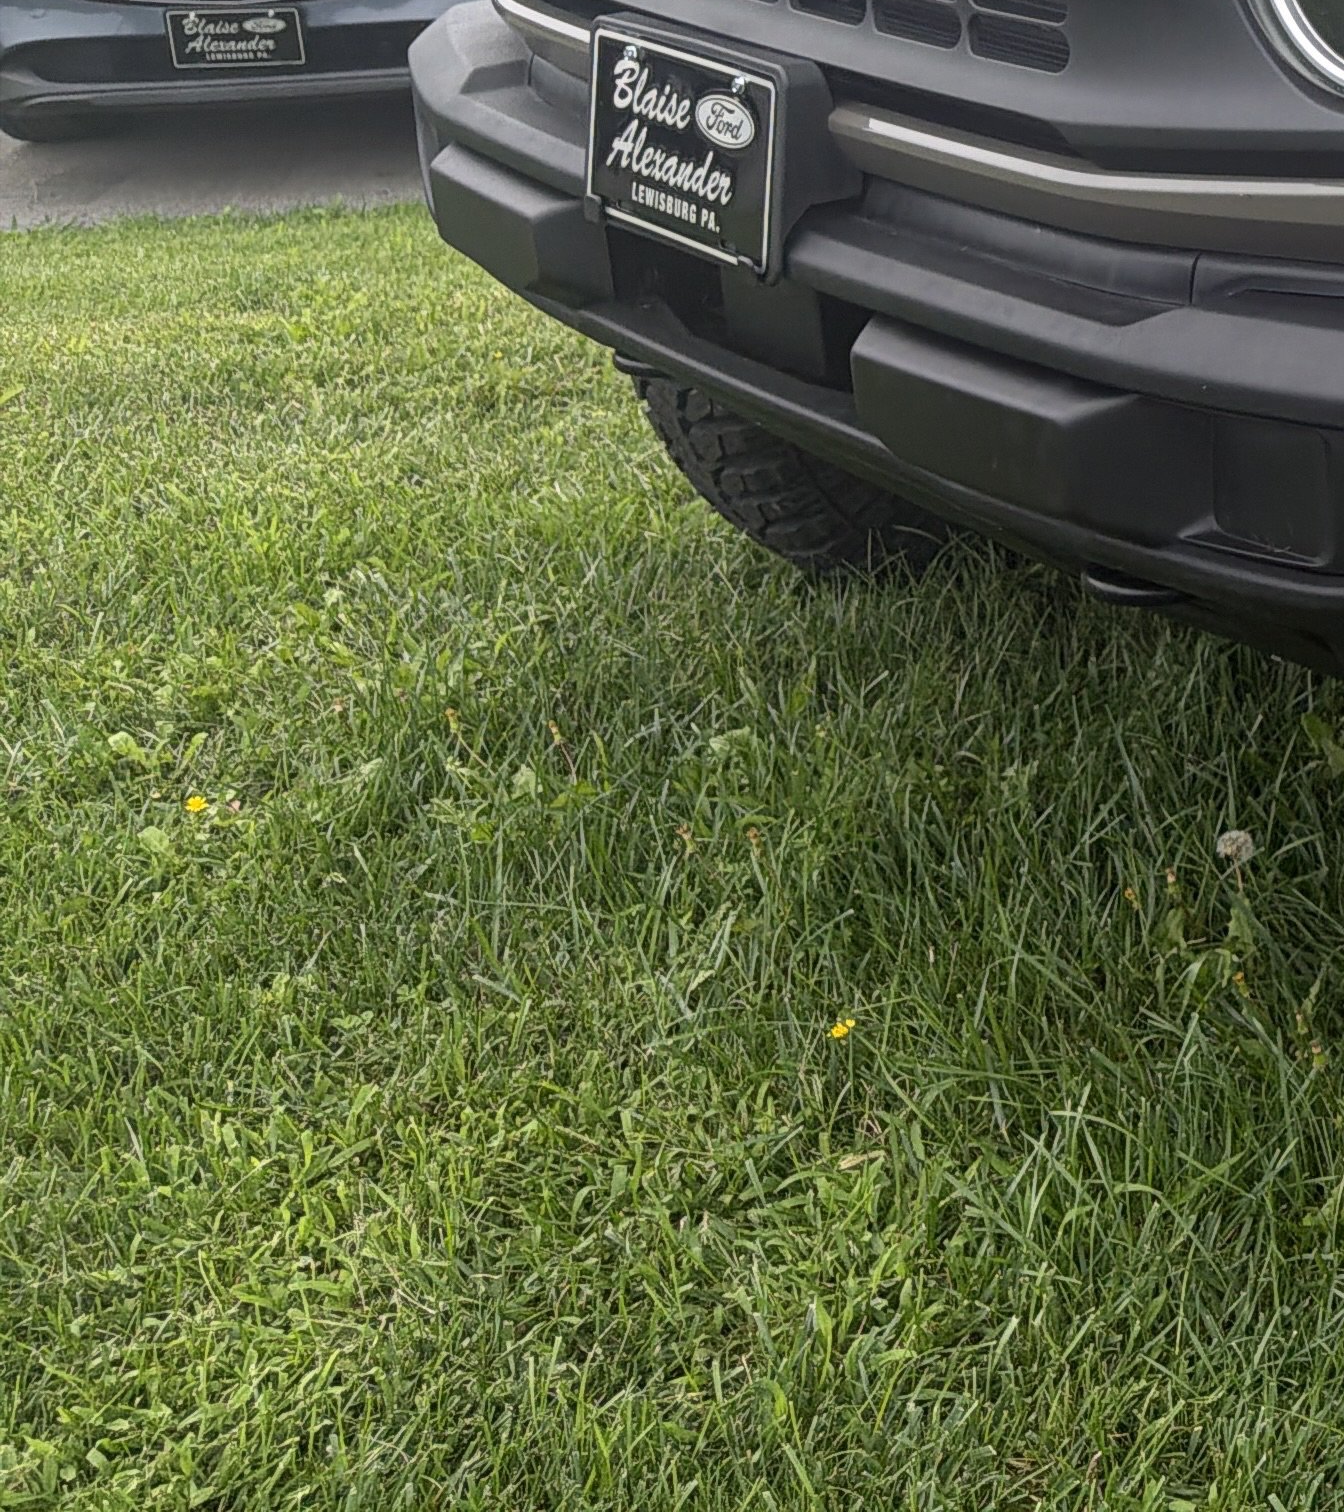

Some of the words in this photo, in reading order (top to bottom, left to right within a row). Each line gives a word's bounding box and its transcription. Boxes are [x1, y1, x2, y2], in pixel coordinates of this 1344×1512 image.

[181, 17, 239, 35] Blaise
[185, 35, 276, 54] Alexander
[613, 59, 691, 130] Blaise
[705, 101, 744, 141] Ford
[606, 119, 733, 206] Alexander
[631, 181, 697, 225] LEWISBURG
[700, 210, 721, 234] PA.
